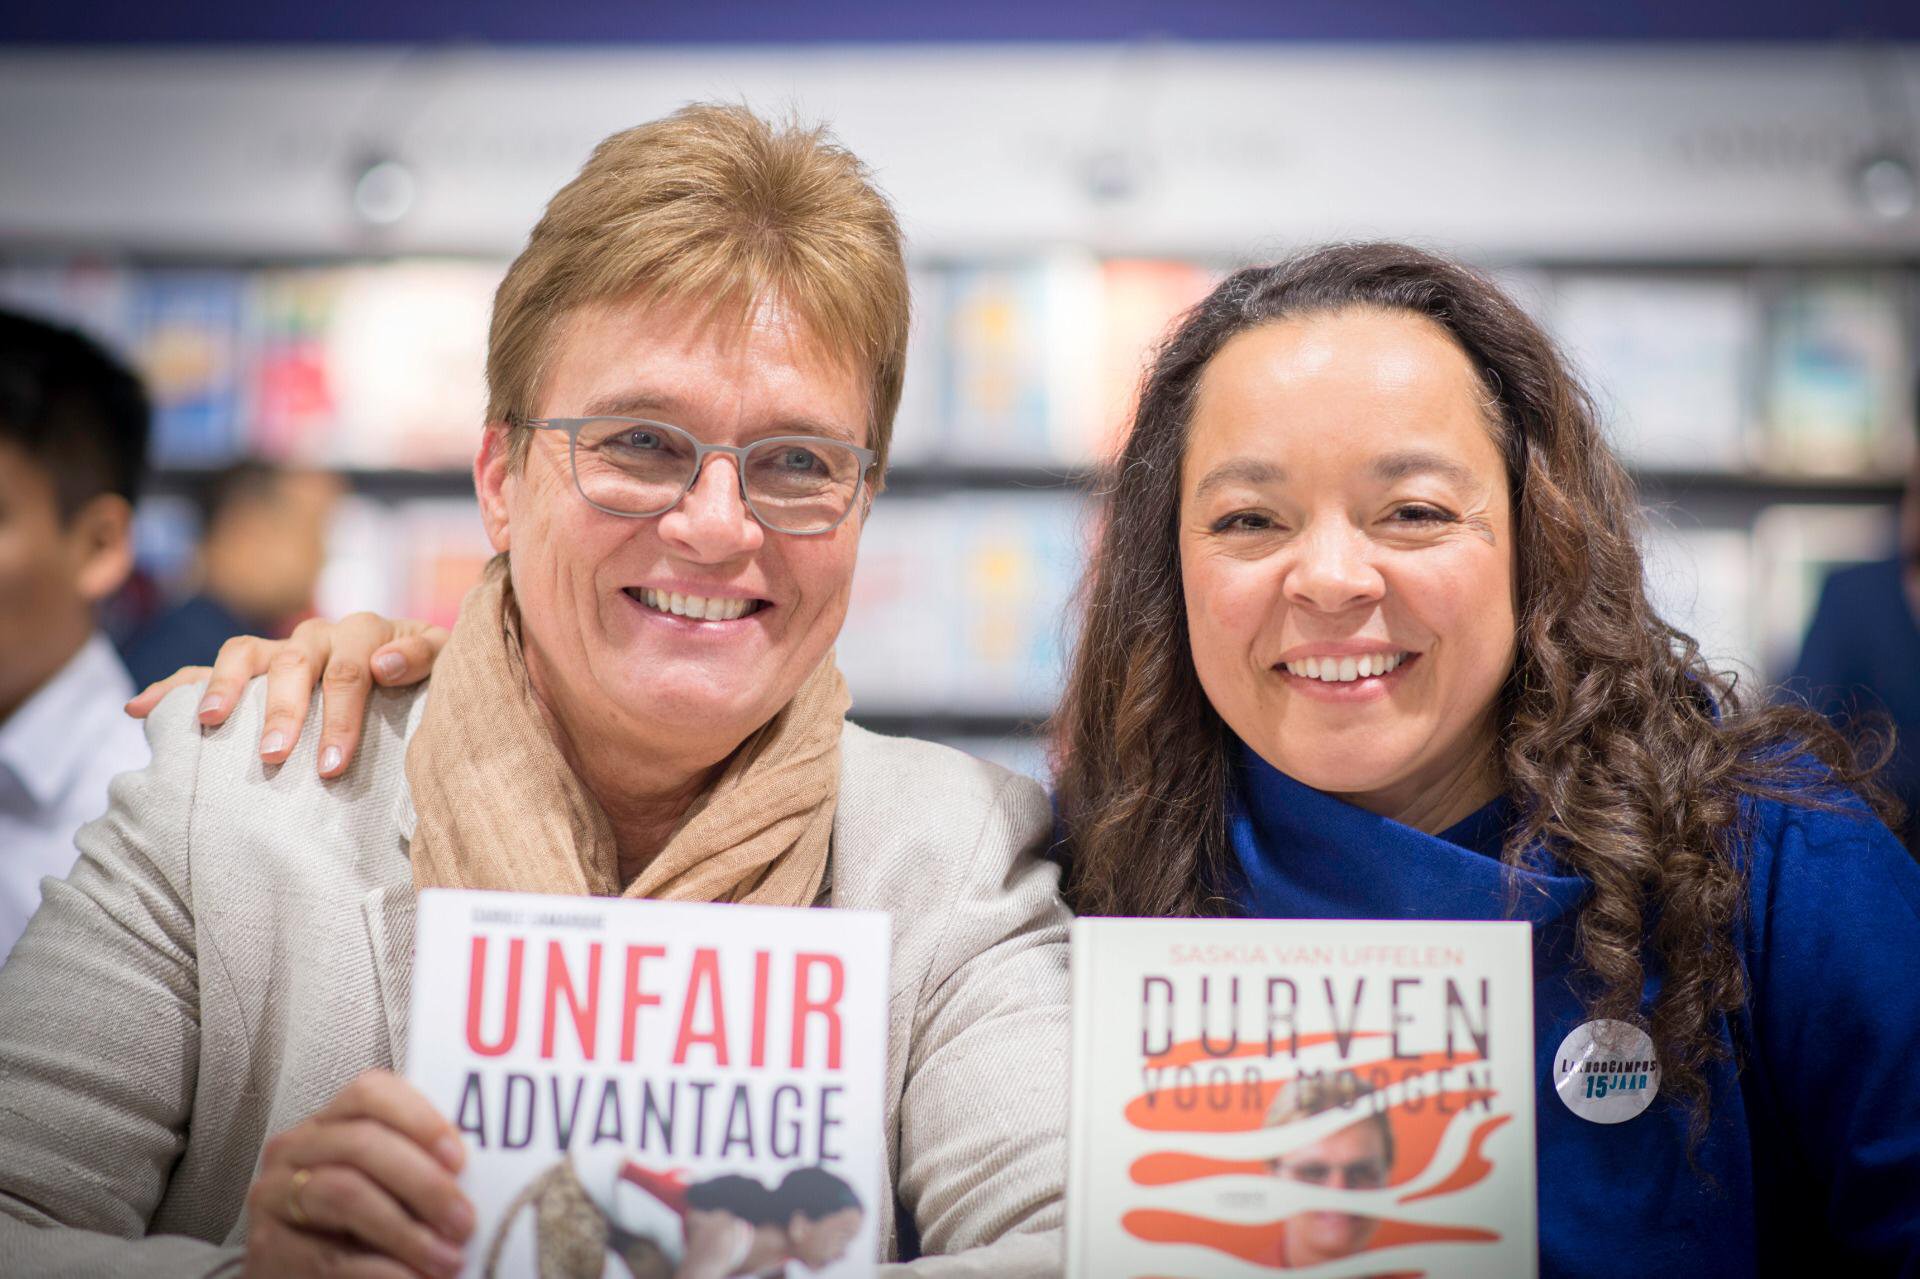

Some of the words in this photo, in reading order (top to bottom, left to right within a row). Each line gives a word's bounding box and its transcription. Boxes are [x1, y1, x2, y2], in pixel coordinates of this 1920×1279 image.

[1168, 943, 1266, 966] SASKIA
[1275, 943, 1333, 966] VAN
[1340, 945, 1465, 967] UFFELEN
[465, 935, 847, 1071] UNFAIR
[1141, 975, 1490, 1061] DURVEN
[455, 1071, 844, 1161] ADVANTAGE
[1142, 1065, 1263, 1112] VOOR
[1295, 1066, 1494, 1115] MORGEN
[1586, 1075, 1609, 1098] 15
[1609, 1074, 1648, 1090] JAAR
